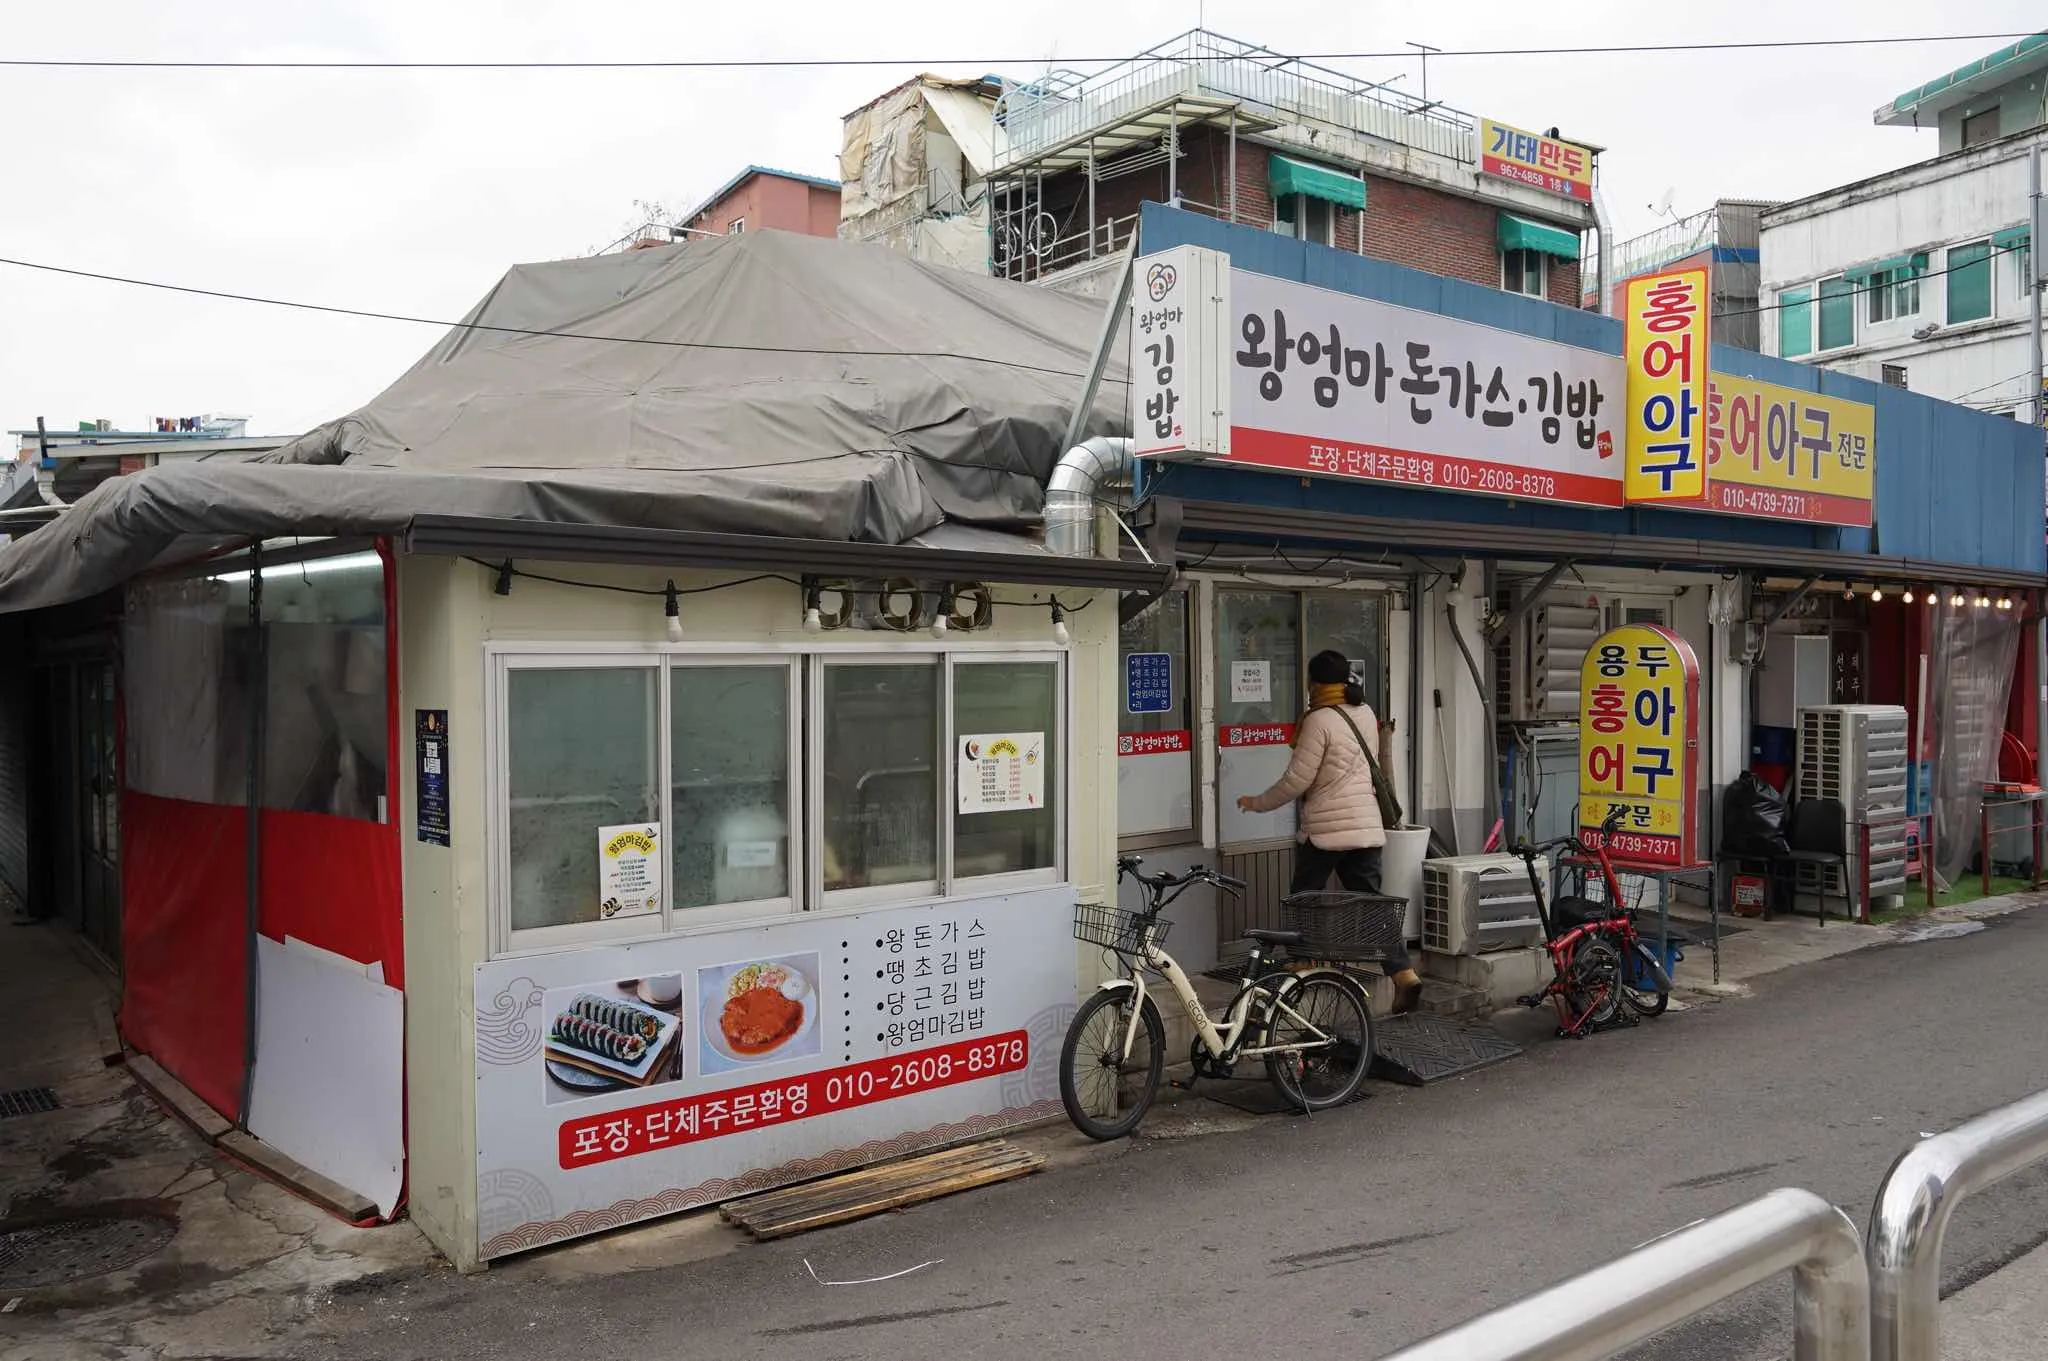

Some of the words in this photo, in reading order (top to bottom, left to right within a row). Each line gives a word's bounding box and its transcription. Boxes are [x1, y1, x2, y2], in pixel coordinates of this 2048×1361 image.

[1491, 126, 1583, 176] 기태만두
[1500, 163, 1544, 186] 962-4858
[1140, 306, 1183, 334] 왕엄마
[1144, 334, 1180, 440] 김밥
[1641, 280, 1698, 492] 홍어아구
[1838, 432, 1866, 470] 전문
[1443, 463, 1555, 497] 010-2608-8378
[1723, 487, 1806, 516] 010-4739-7371
[1596, 645, 1670, 678] 용두
[886, 1007, 985, 1046] 왕엄마김밥
[826, 1039, 1024, 1104] 010-2608-8378
